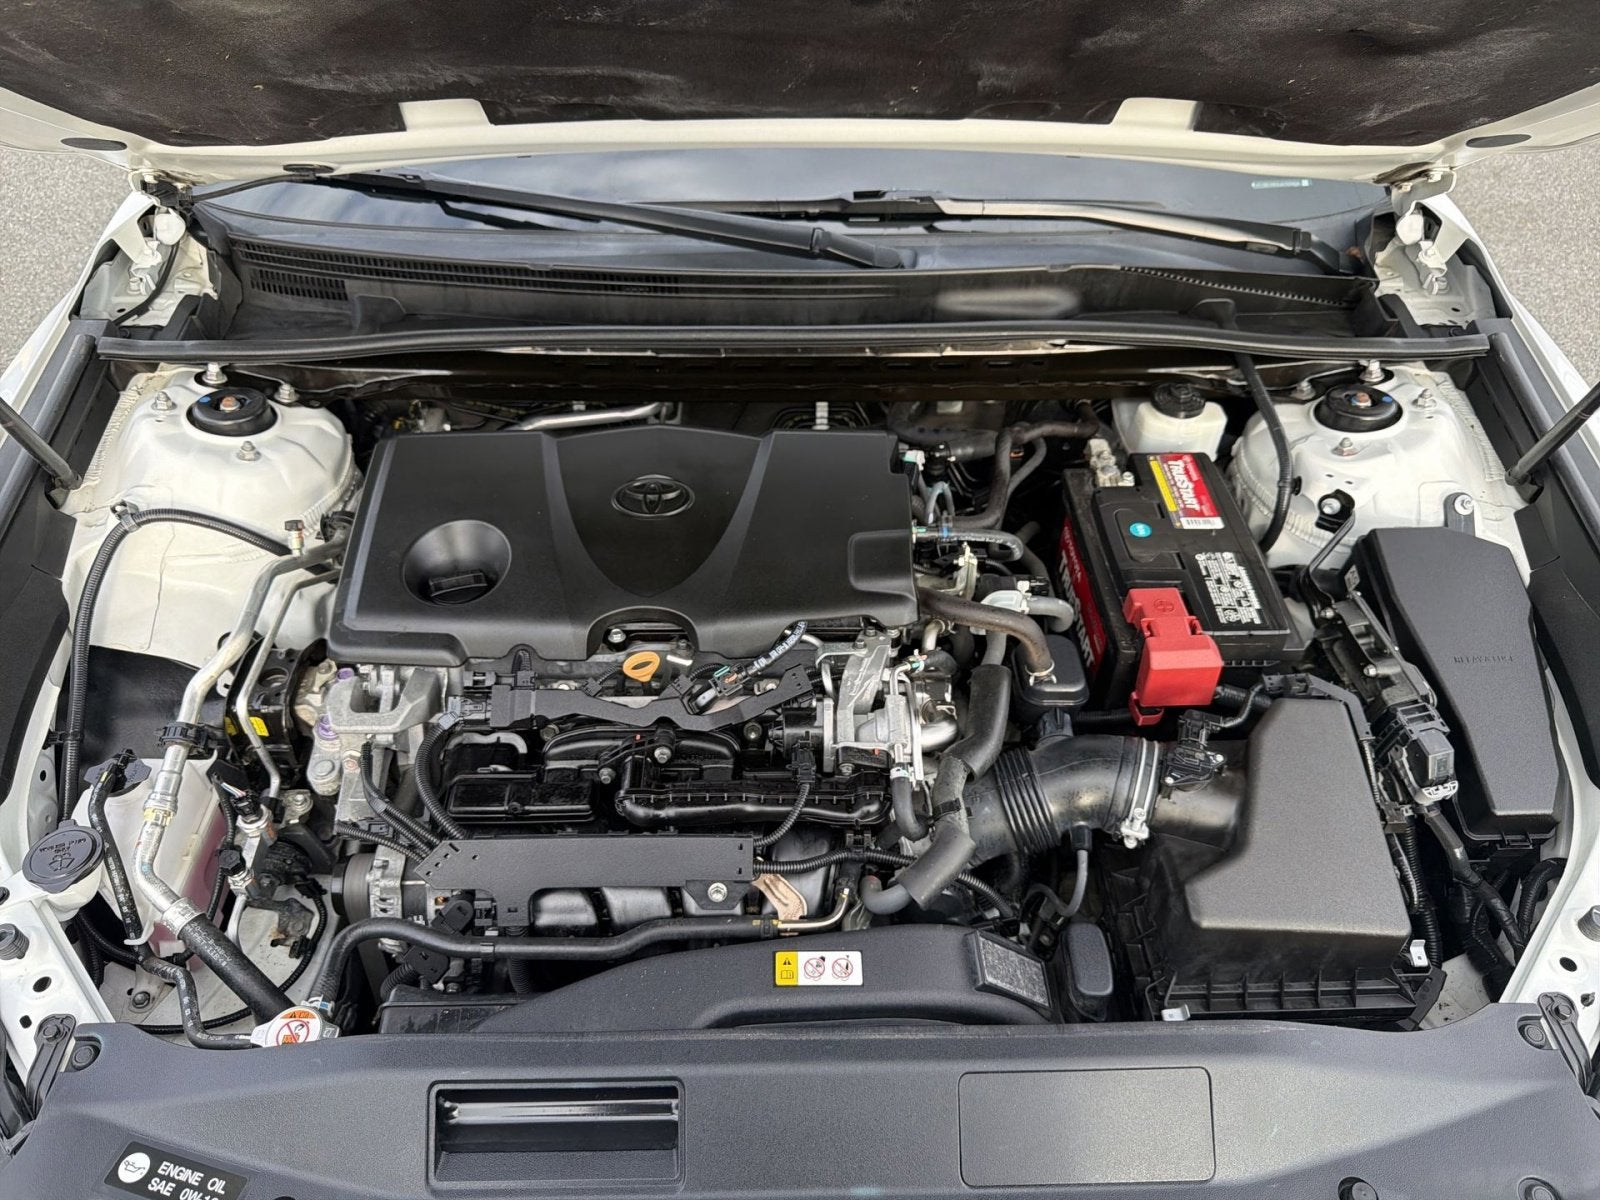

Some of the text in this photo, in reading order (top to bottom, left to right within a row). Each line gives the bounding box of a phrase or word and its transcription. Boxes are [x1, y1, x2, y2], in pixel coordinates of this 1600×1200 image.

[147, 1177, 177, 1197] SAE
[157, 1161, 226, 1195] ENGINE OIL
